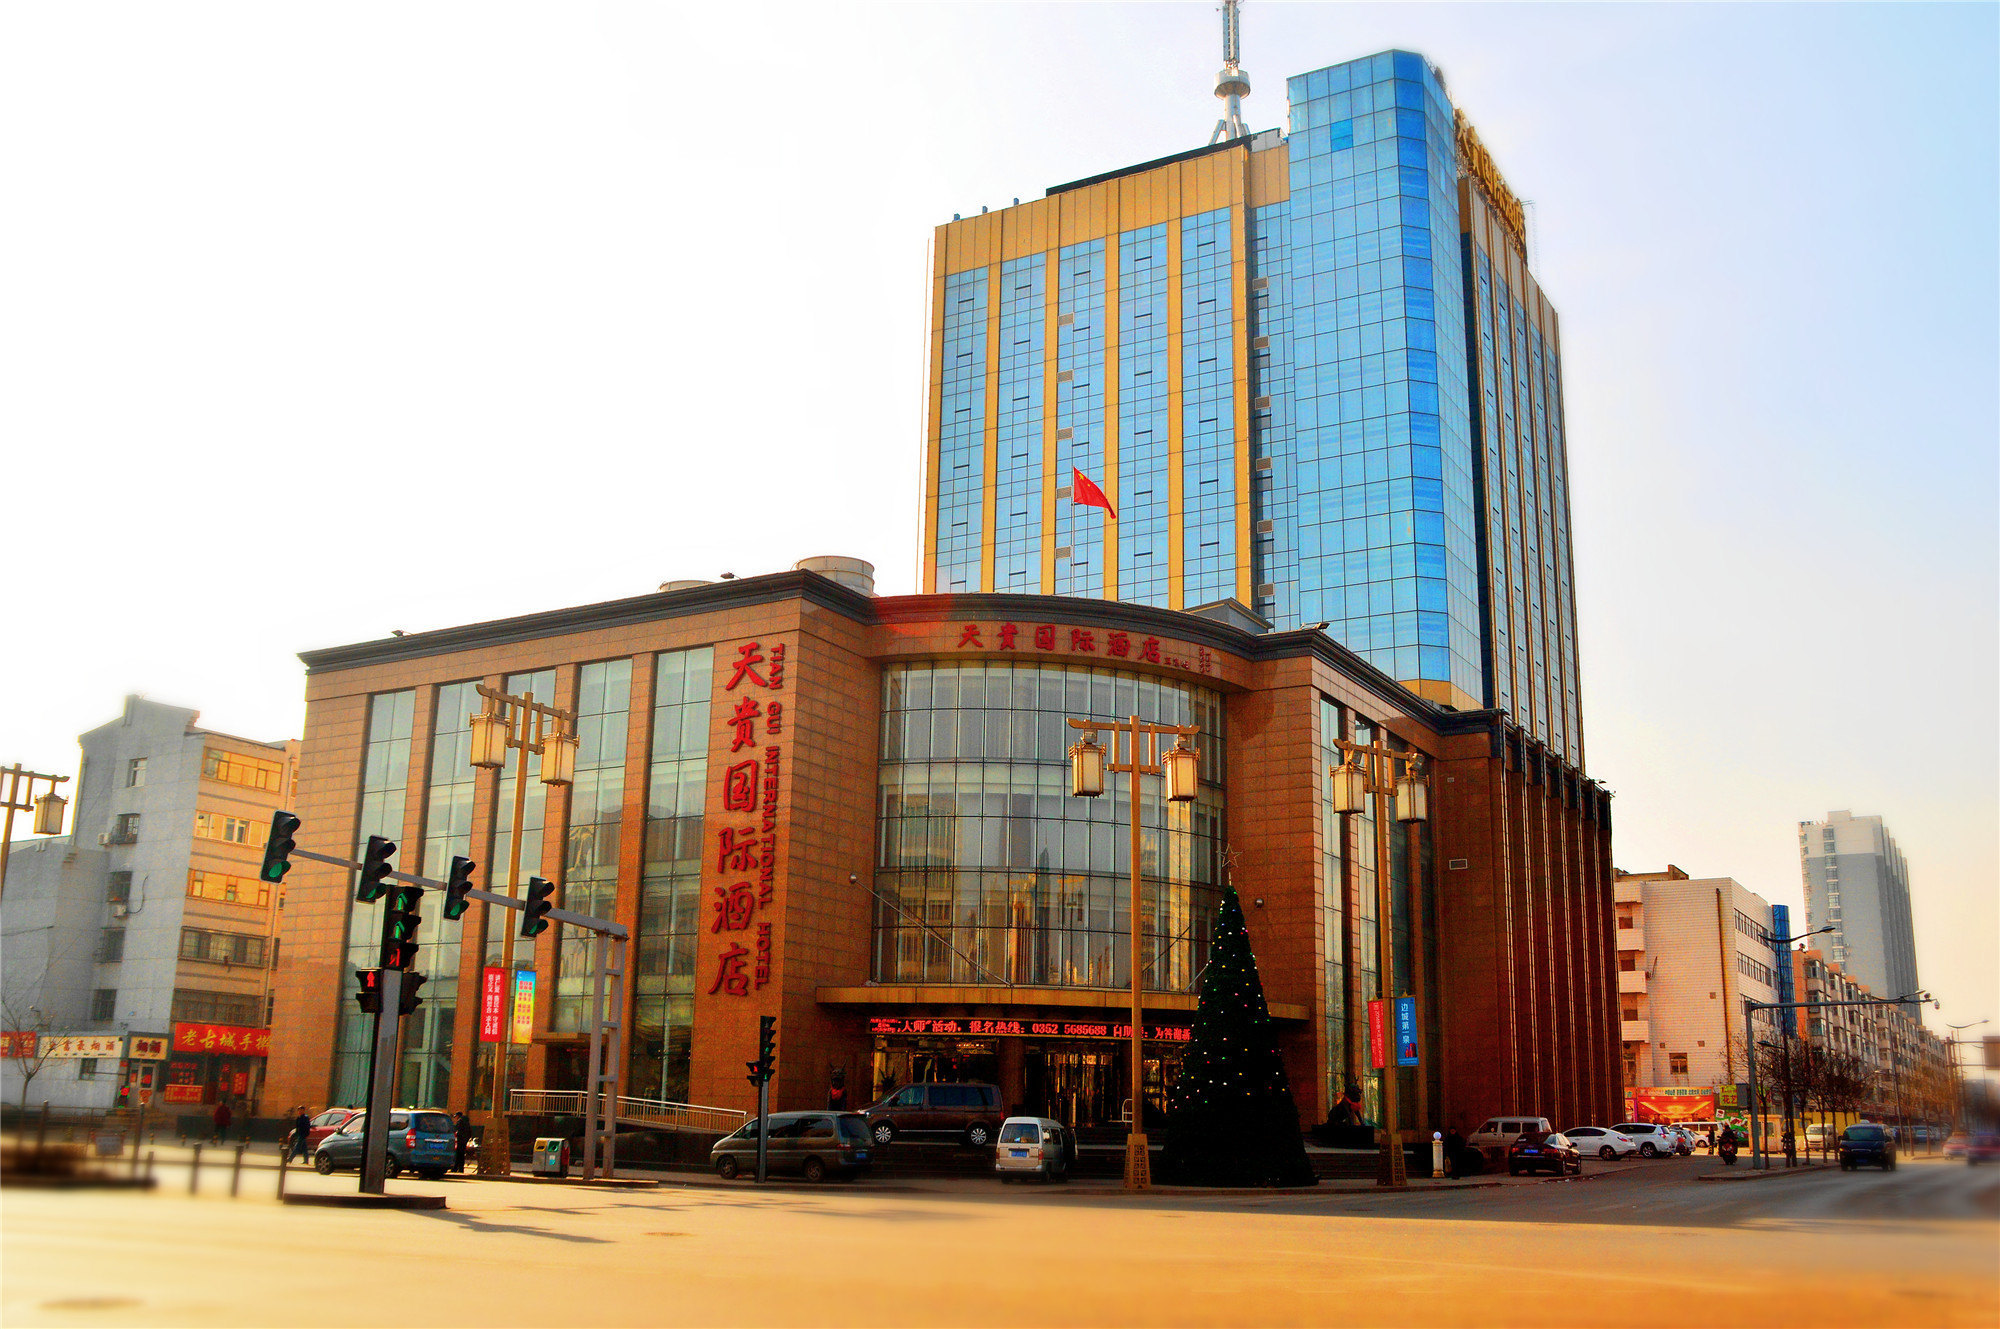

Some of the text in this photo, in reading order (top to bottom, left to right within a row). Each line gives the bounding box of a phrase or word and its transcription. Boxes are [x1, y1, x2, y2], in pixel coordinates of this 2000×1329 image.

[957, 621, 1161, 663] 天贵国际酒店
[708, 641, 767, 996] 天贵国际酒店
[754, 643, 785, 991] TIAN GUI INTERNATIONAL HOTEL
[1032, 1023, 1059, 1034] 0352
[1064, 1024, 1107, 1036] 5685688
